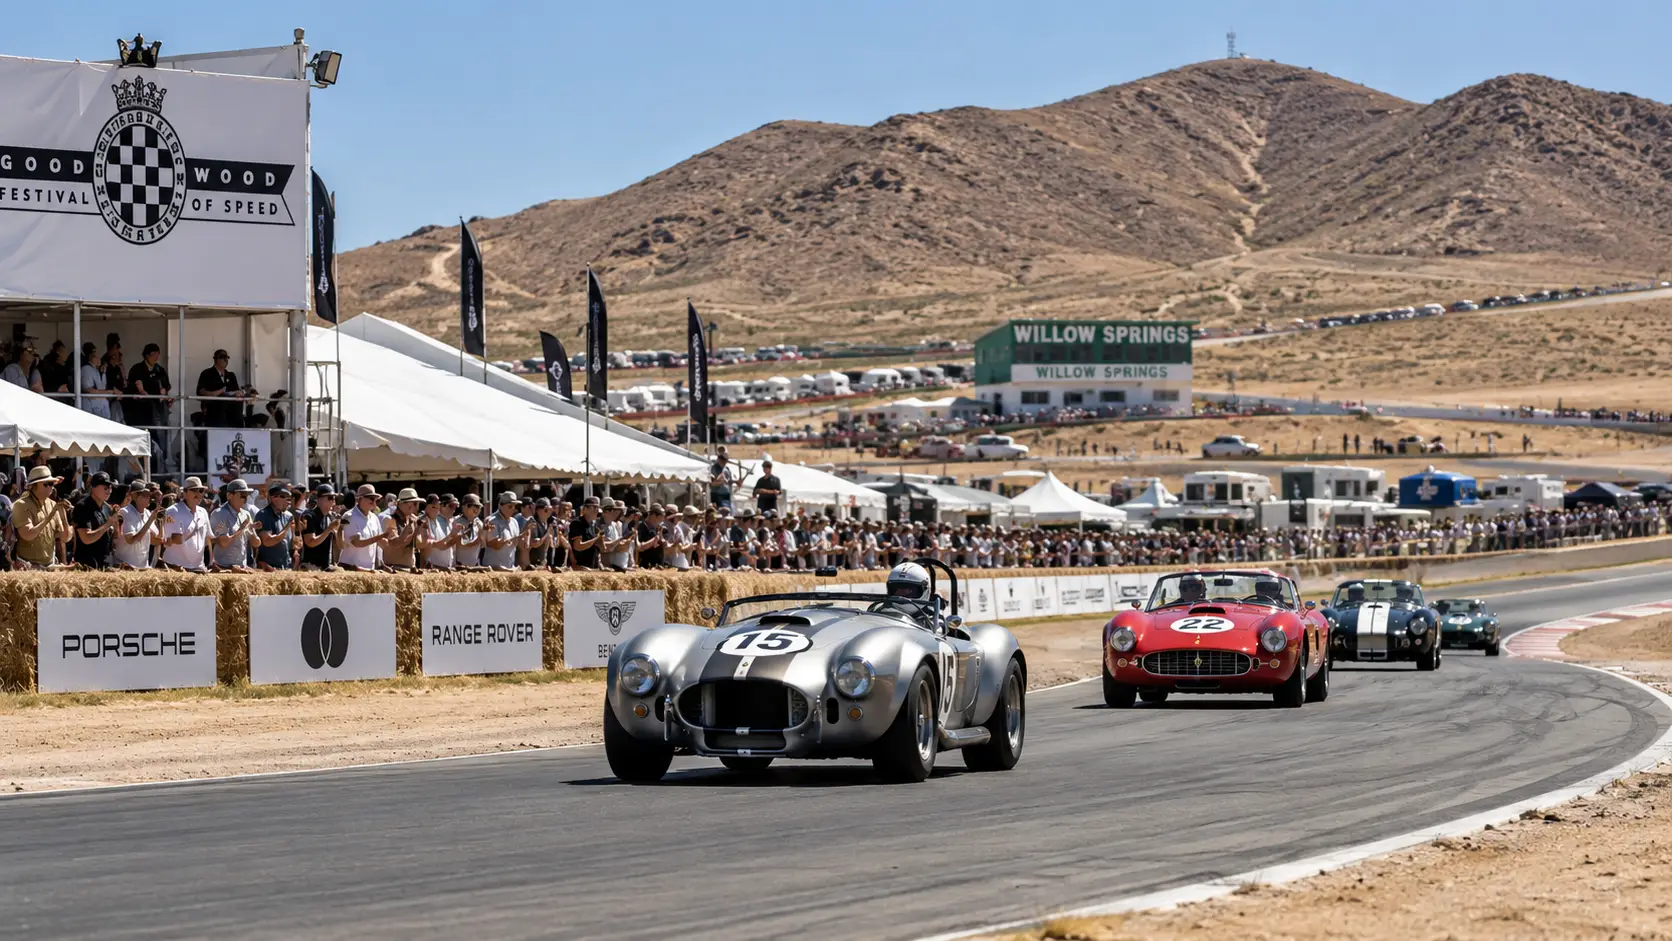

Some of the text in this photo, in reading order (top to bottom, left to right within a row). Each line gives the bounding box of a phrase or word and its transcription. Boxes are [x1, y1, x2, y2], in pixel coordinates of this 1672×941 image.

[0, 154, 276, 187] GOOD WOOD
[0, 187, 278, 215] FESTIVAL OF SPEED
[1013, 325, 1190, 343] WILLOW SPRINGS
[1036, 366, 1168, 379] WILLOW SPRINGS
[1179, 618, 1225, 630] 22
[432, 623, 534, 646] RANGE ROVER
[735, 632, 799, 650] 15
[62, 632, 196, 659] PORSCHE
